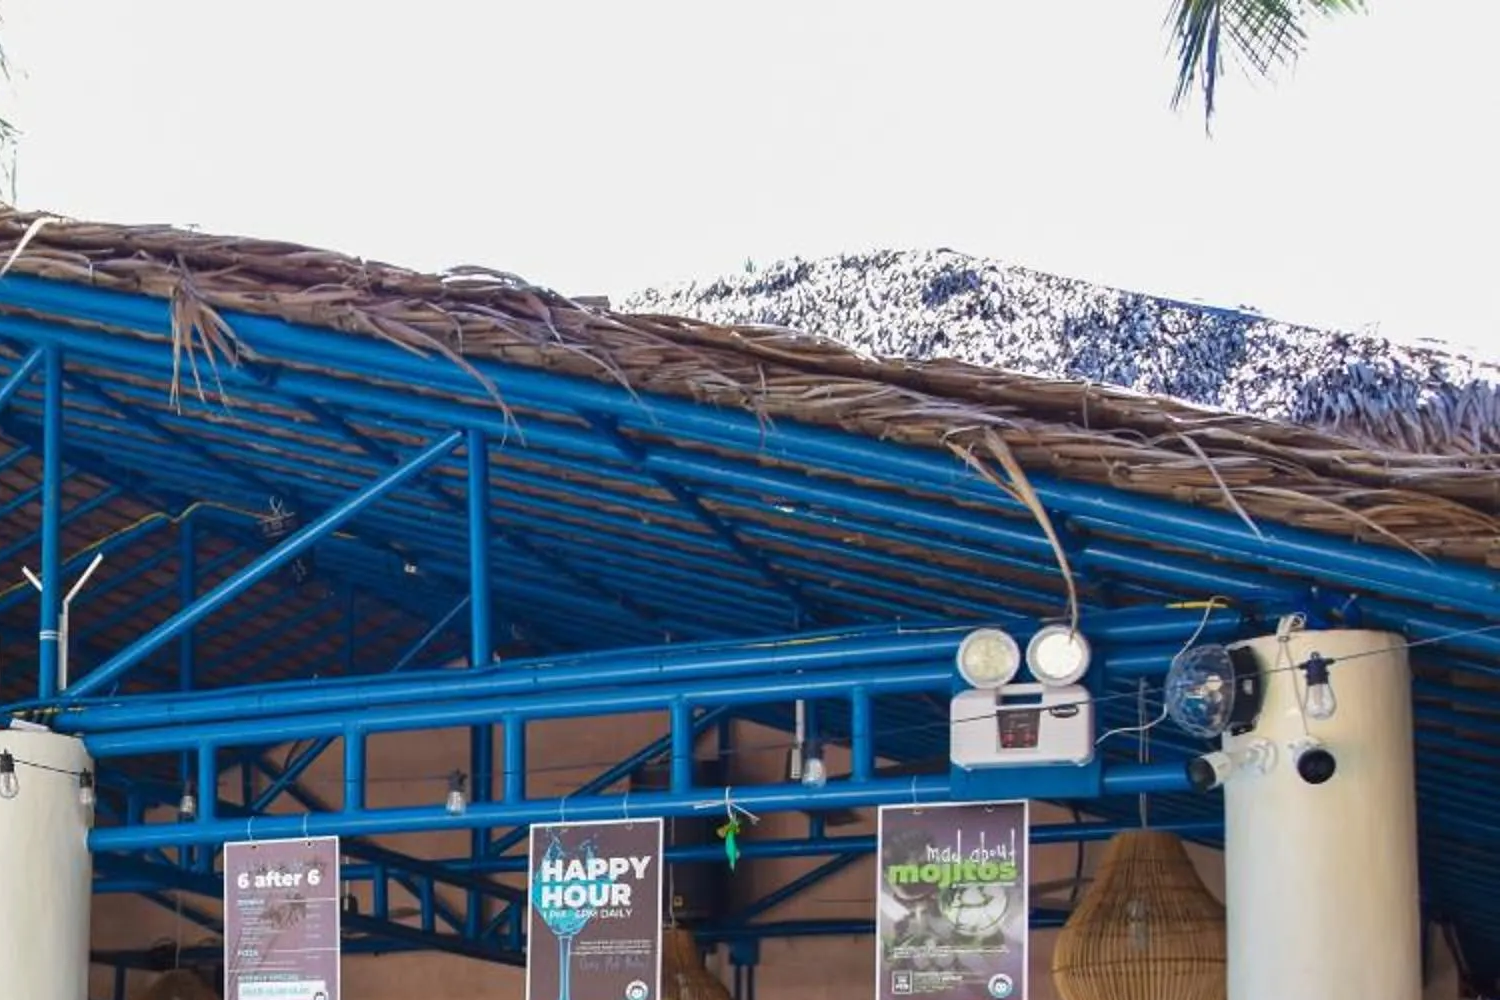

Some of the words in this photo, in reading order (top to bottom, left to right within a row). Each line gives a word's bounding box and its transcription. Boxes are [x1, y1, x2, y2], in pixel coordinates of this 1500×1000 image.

[926, 829, 961, 865] mad
[970, 828, 1015, 867] about
[237, 872, 250, 889] 6
[254, 870, 303, 888] after
[307, 868, 320, 886] 6
[542, 856, 652, 883] HAPPY
[887, 858, 1018, 888] mojitos
[541, 883, 632, 909] HOUR
[600, 908, 633, 919] DAILY
